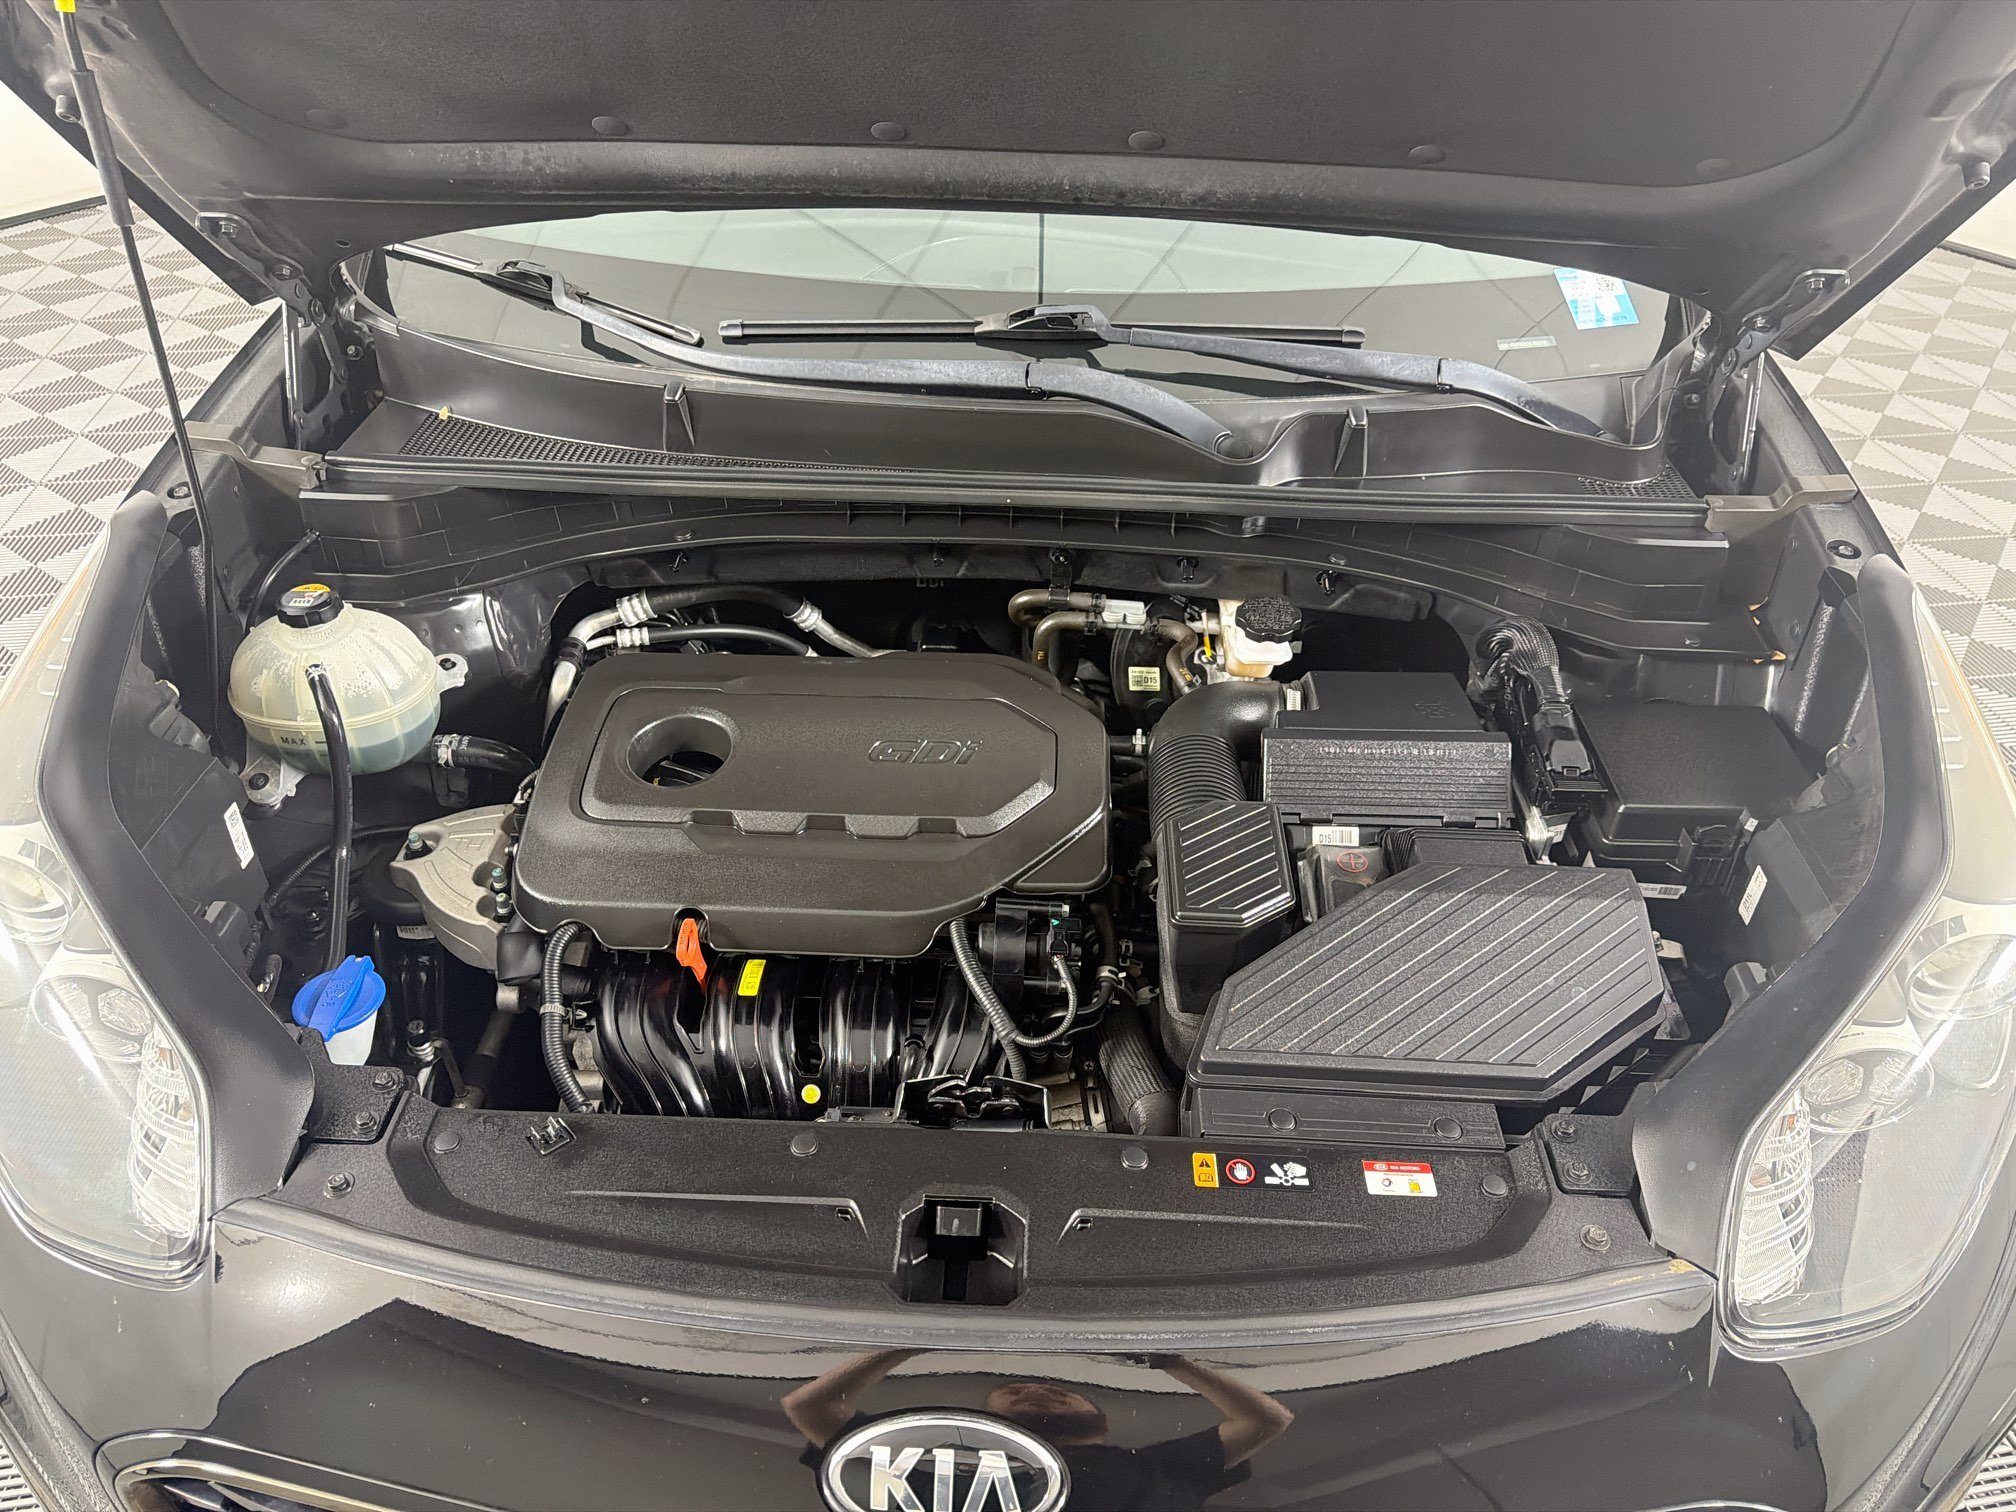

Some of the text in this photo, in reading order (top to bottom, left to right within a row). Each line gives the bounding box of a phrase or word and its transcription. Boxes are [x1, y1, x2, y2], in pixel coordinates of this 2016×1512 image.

[1143, 676, 1158, 684] D15
[280, 736, 307, 746] MAX
[866, 740, 983, 764] GDi
[869, 1445, 1021, 1512] KIA
